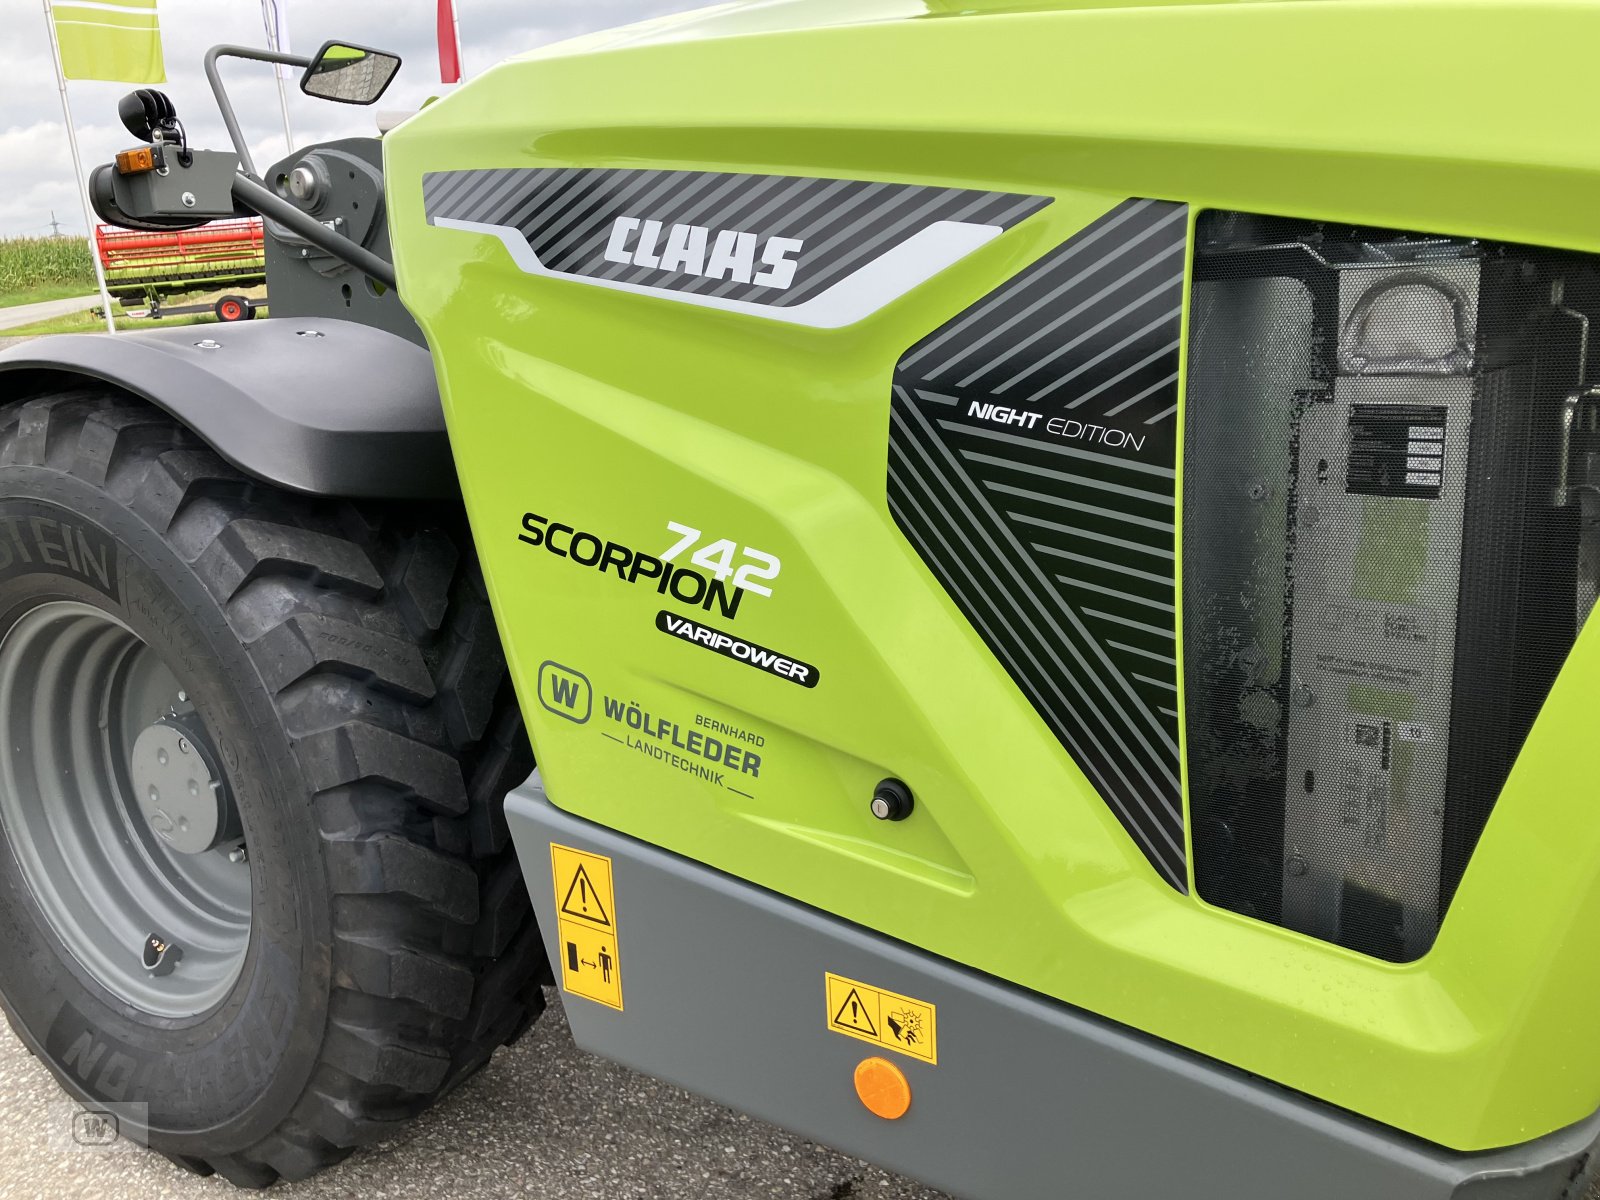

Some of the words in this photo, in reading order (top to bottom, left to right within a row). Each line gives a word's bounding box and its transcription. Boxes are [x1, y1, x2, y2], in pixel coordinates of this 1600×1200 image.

[604, 216, 804, 290] CLAAS
[968, 401, 1043, 429] NIGHT
[1046, 417, 1146, 451] EDITION
[518, 512, 744, 620] SCORPION
[658, 520, 781, 598] 742
[665, 614, 811, 684] VARIPOWER
[551, 673, 580, 709] W
[603, 695, 762, 778] WÖLFLEDER
[626, 735, 725, 787] LANDTECHNIK
[695, 714, 765, 748] BERNHARD
